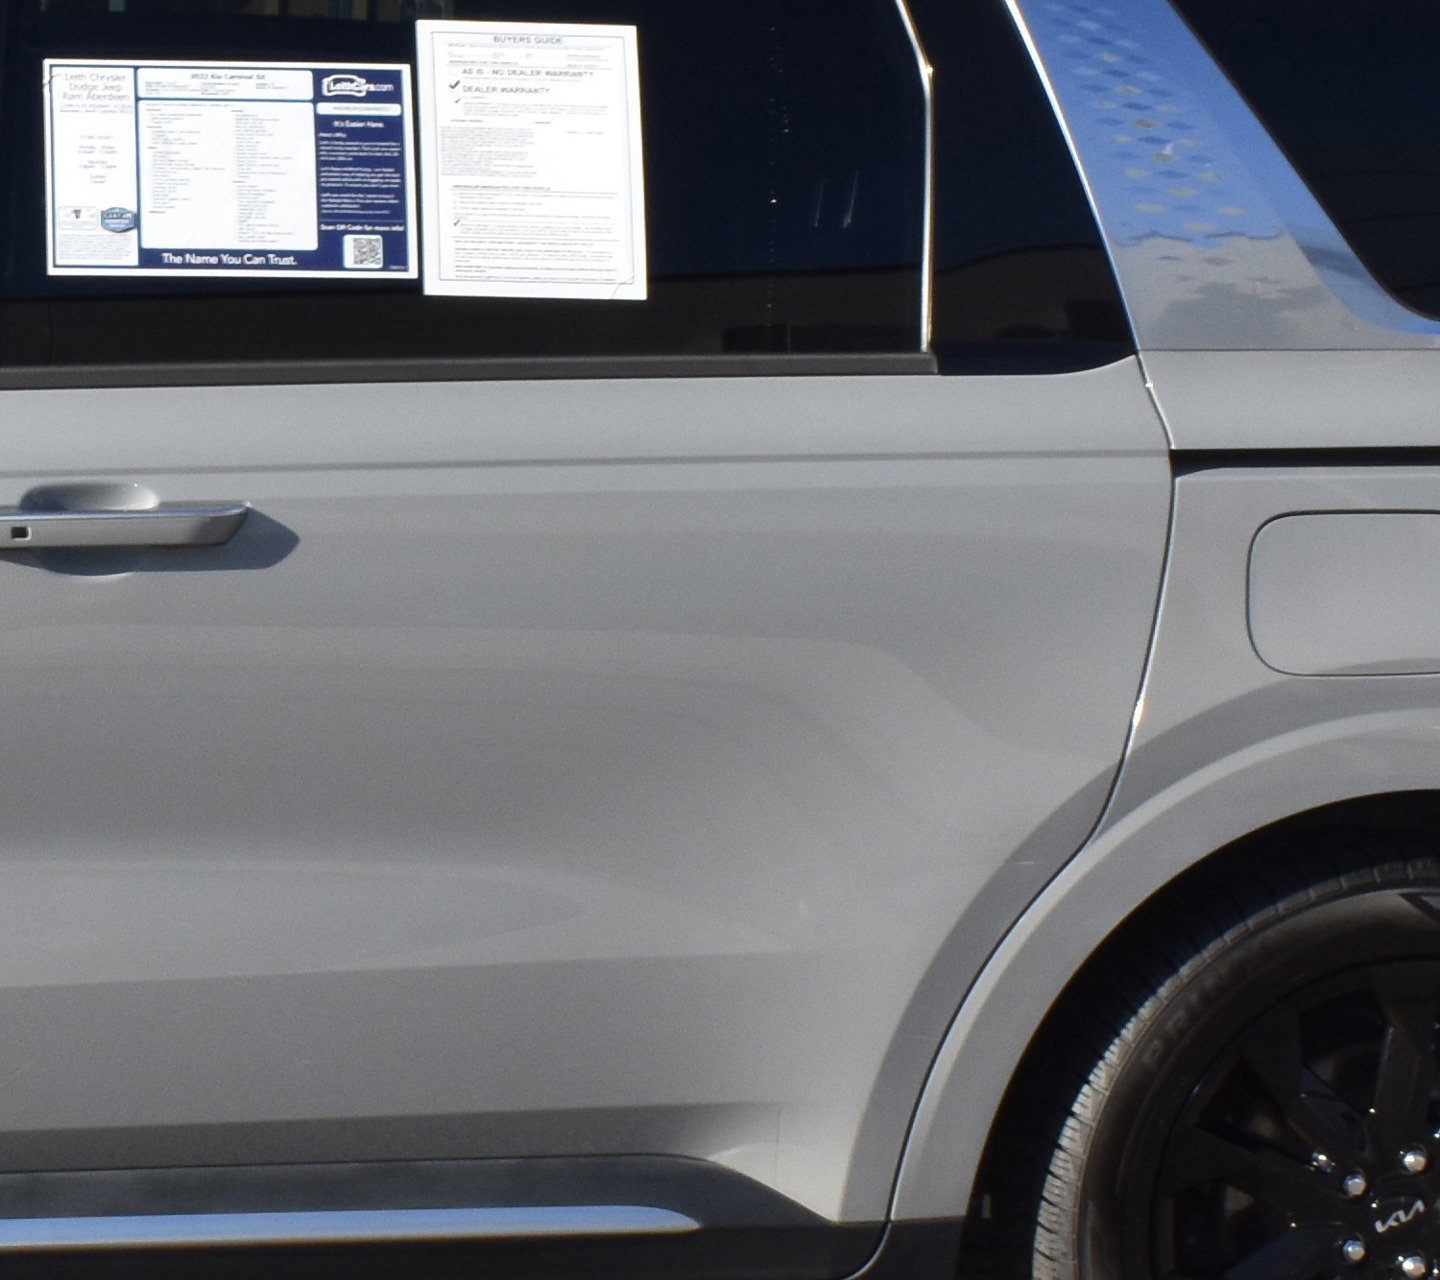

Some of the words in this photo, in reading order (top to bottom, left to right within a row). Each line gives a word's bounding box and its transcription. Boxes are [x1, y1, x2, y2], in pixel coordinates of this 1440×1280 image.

[493, 35, 532, 44] BUYERS
[534, 36, 564, 45] GUIDE
[507, 69, 543, 77] DEALER
[545, 70, 594, 78] WARRANTY
[462, 85, 498, 93] DEALER
[501, 86, 550, 94] WARRANTY
[161, 253, 182, 264] The
[185, 253, 219, 265] Name
[221, 253, 242, 265] You
[244, 254, 266, 265] Can
[268, 254, 298, 266] Trust.
